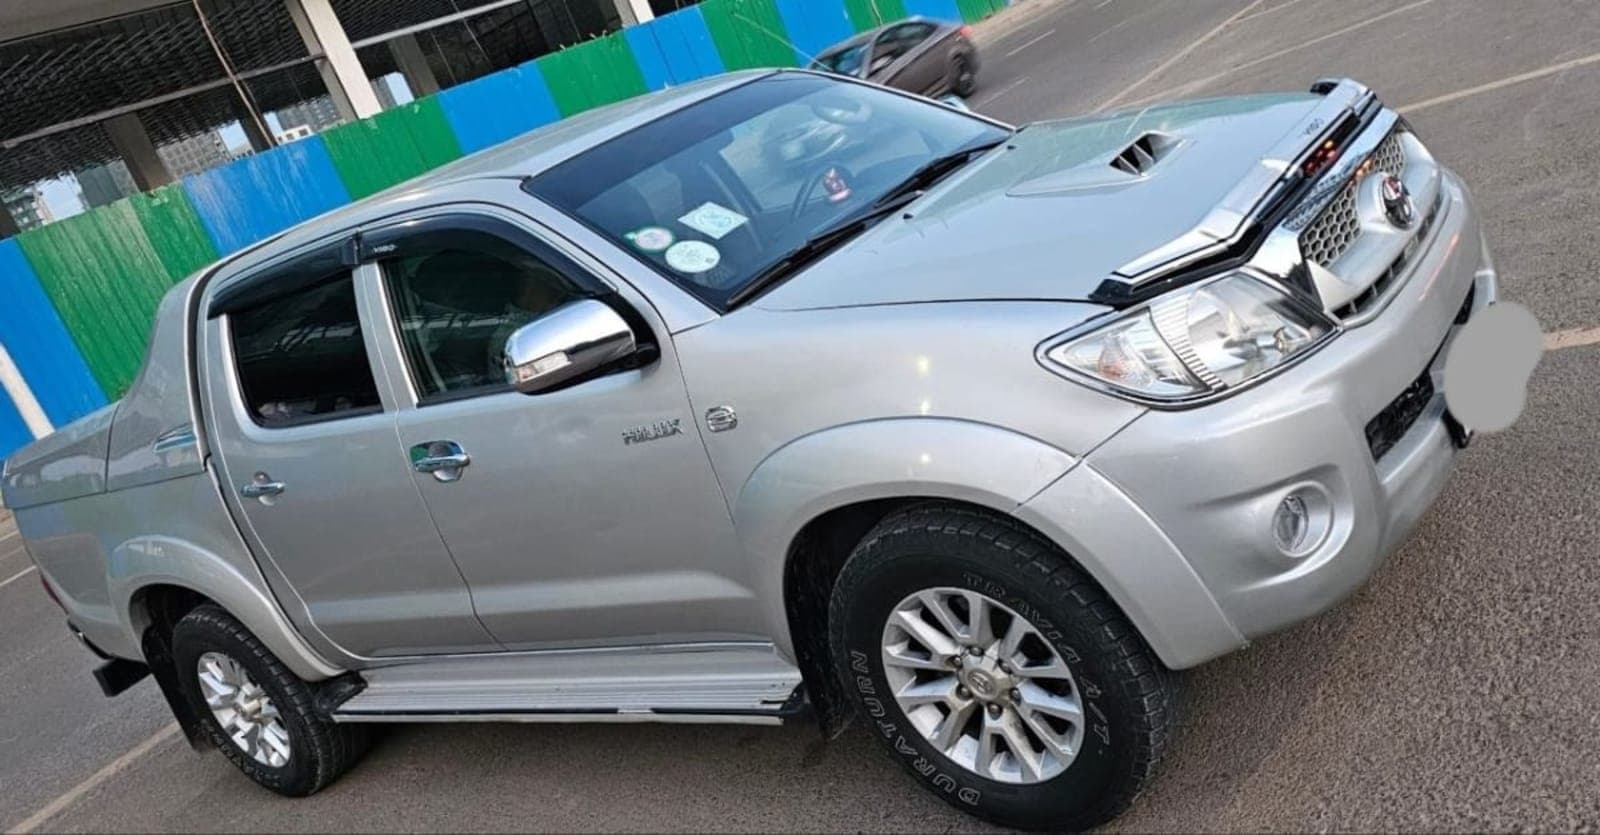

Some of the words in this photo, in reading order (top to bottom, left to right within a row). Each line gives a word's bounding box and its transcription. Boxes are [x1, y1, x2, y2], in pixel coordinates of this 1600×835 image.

[622, 418, 683, 446] HILUX
[851, 650, 981, 806] DURATURN
[1079, 675, 1111, 746] A/T
